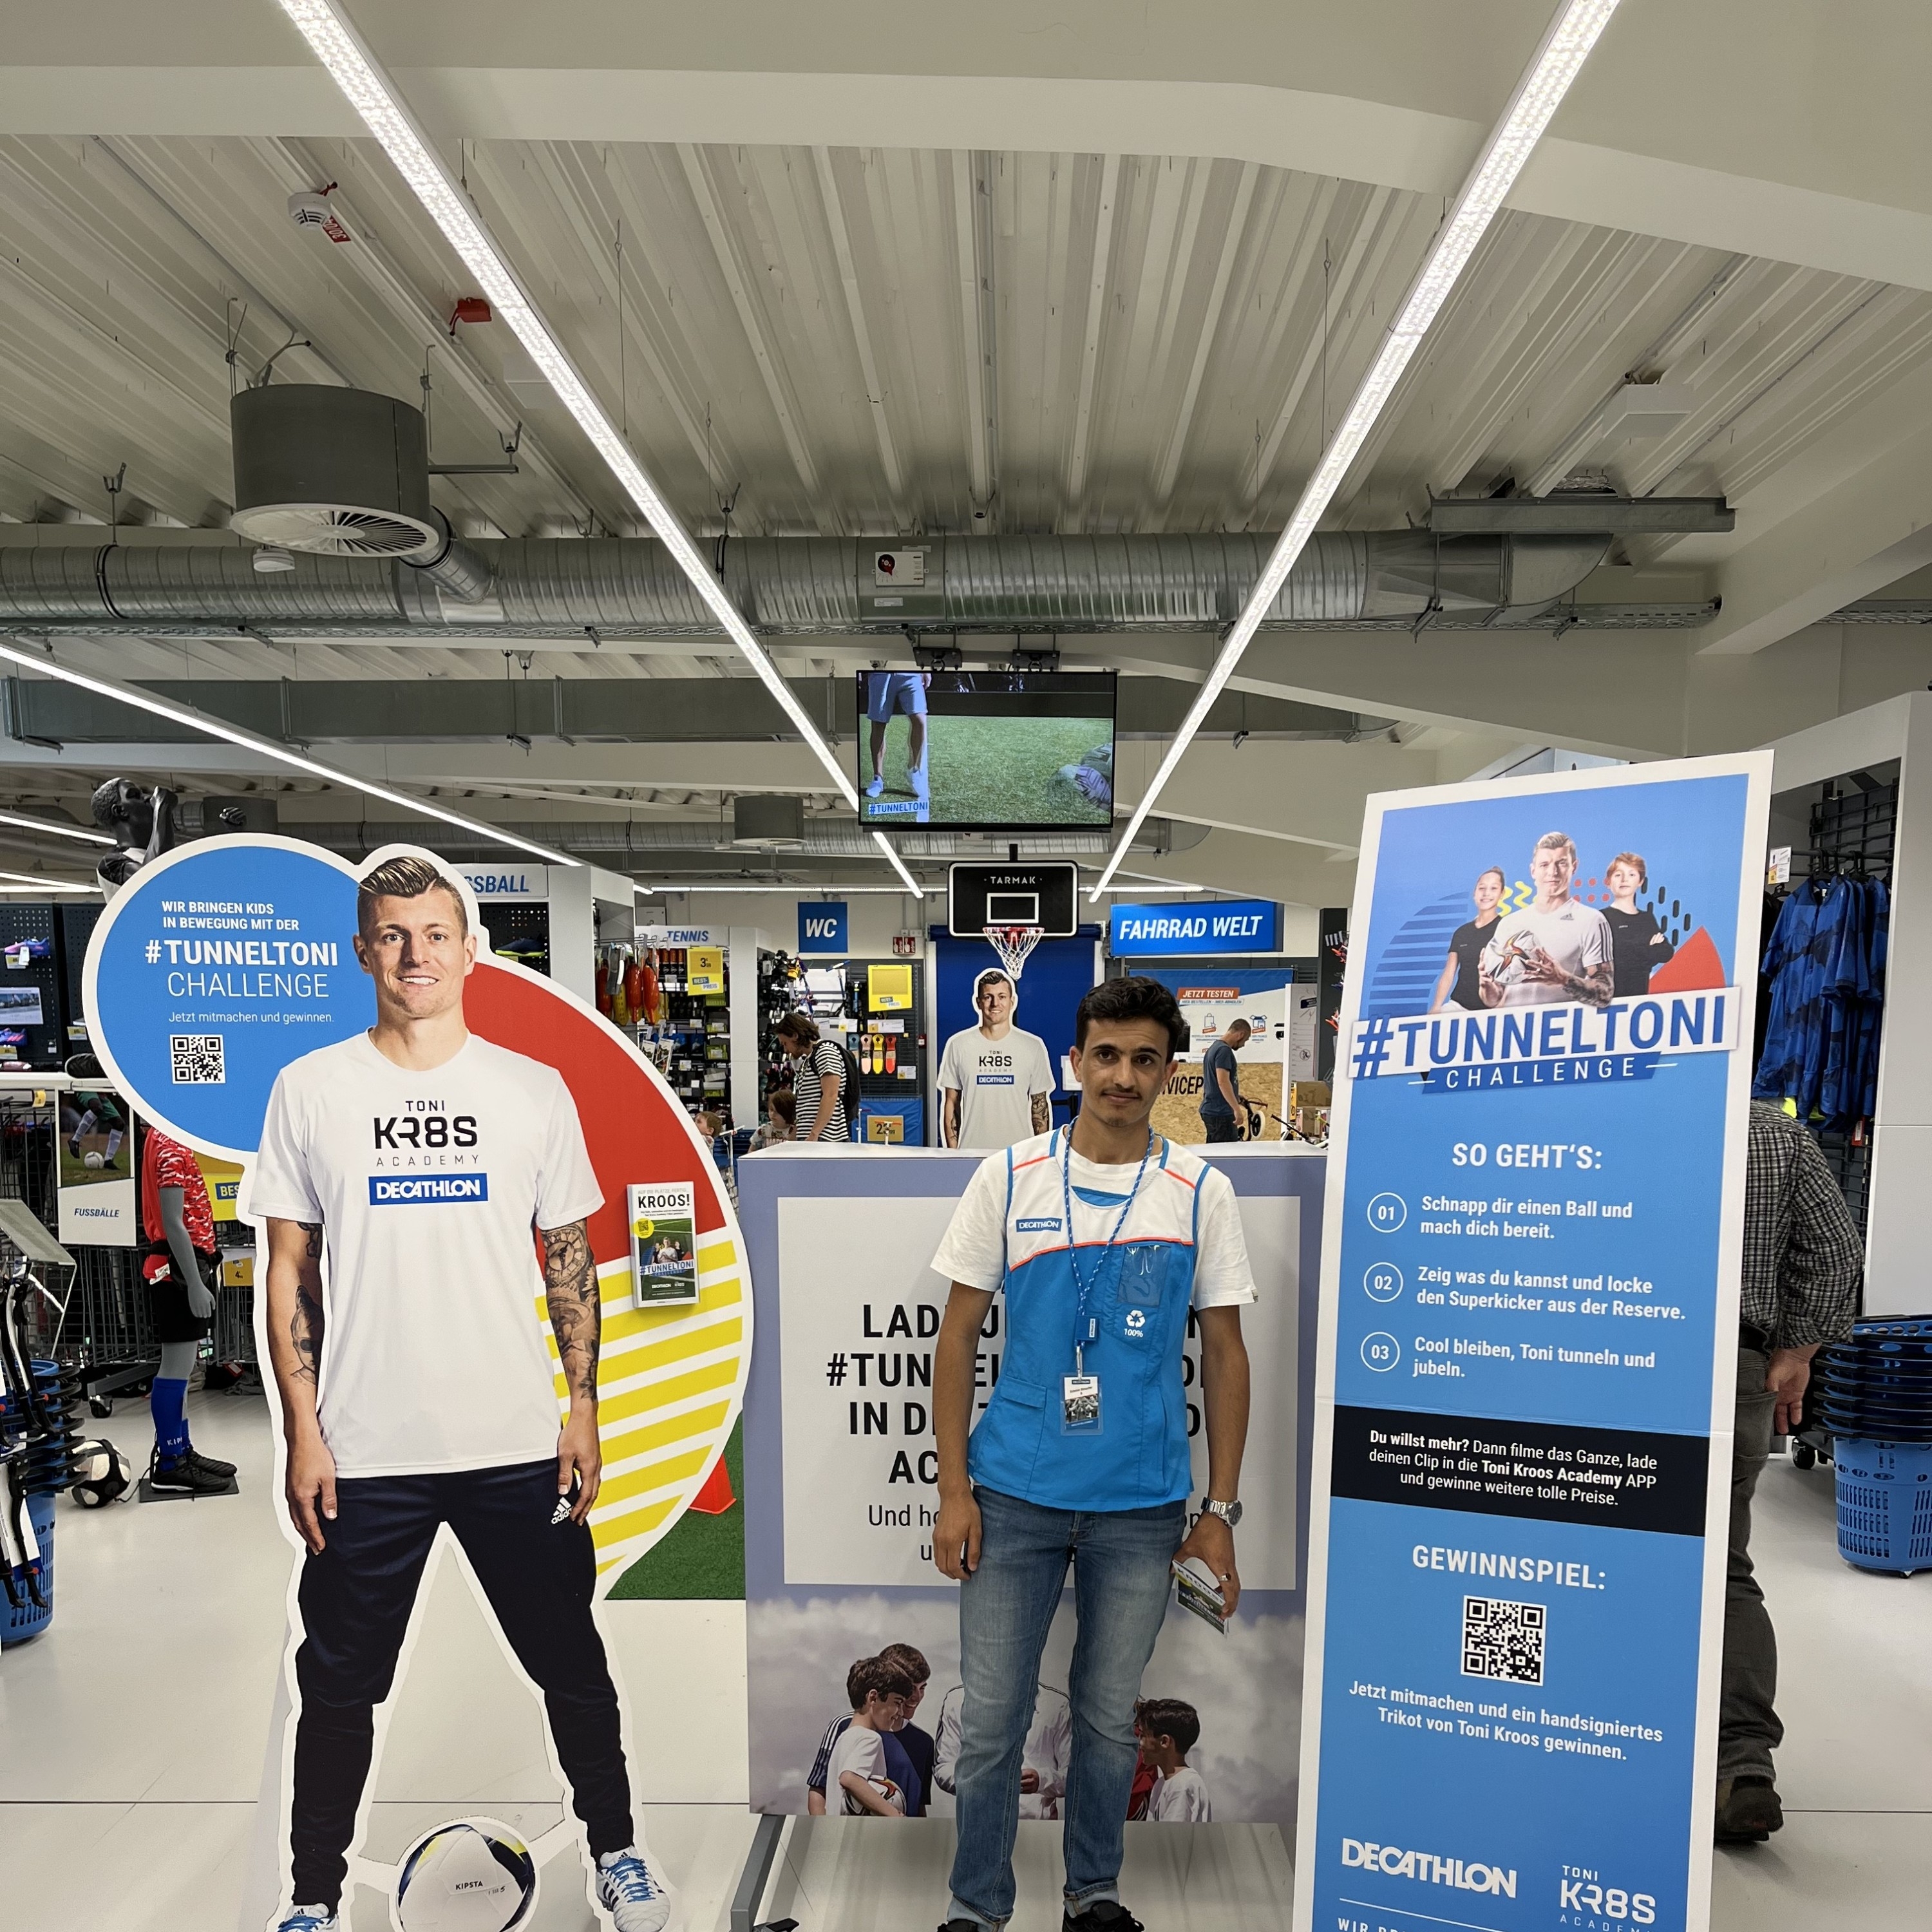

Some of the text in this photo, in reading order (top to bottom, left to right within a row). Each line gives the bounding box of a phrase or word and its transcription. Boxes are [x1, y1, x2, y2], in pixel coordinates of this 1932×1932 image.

[869, 801, 928, 815] #TUNNELTONI
[162, 901, 274, 914] WIR BRINGEN KIDS
[163, 917, 299, 931] IN BEWEGUNG MIT DER
[806, 918, 837, 938] WC
[1119, 916, 1263, 940] FAHRRAD WELT
[667, 931, 708, 942] TENNIS
[145, 940, 338, 966] #TUNNELTONI
[167, 972, 329, 998] CHALLENGE
[169, 1012, 334, 1024] Jetzt mitmachen und gewinnen.
[1353, 996, 1725, 1080] #TUNNELTONI
[1446, 1057, 1634, 1088] CHALLENGE
[406, 1100, 445, 1112] TONI
[374, 1116, 478, 1149] KR8S
[376, 1155, 478, 1167] ACADEMY
[1453, 1143, 1486, 1167] SO
[220, 1185, 239, 1197] BES
[376, 1179, 480, 1199] DECATHLON
[638, 1194, 690, 1208] KROOS!
[1422, 1196, 1632, 1218] Schnapp dir einen Ball und
[74, 1208, 120, 1218] FUSSBÄLLE
[1378, 1206, 1394, 1220] 01
[1019, 1220, 1059, 1229] DECATHLON
[1421, 1220, 1555, 1239] mach dich bereit.
[640, 1260, 694, 1275] #TUNNELTONI
[1374, 1275, 1392, 1290] 02
[1418, 1267, 1653, 1293] Zeig was du kannst und locke
[1417, 1289, 1685, 1320] den Superkicker aus der Reserve.
[864, 1304, 948, 1338] LAD
[1124, 1329, 1143, 1338] 100%
[1371, 1345, 1389, 1360] 03
[1415, 1337, 1654, 1367] Cool bleiben, Toni tunneln und
[1412, 1359, 1465, 1378] jubeln.
[850, 1402, 887, 1435] IN
[1370, 1430, 1657, 1469] Du willst mehr? Dann filme das Ganze, lade
[1369, 1450, 1656, 1488] deinen Clip in die Toni Kroos Academy APP
[1401, 1472, 1618, 1505] und gewinne weitere tolle Preise.
[869, 1504, 911, 1526] Und
[1413, 1545, 1605, 1589] GEWINNSPIEL:
[1349, 1681, 1663, 1741] Jetzt mitmachen und ein handsigniertes
[1378, 1707, 1627, 1760] Trikot von Toni Kroos gewinnen.
[1341, 1838, 1517, 1898] DECATHLON
[1562, 1865, 1598, 1881] TONI
[455, 1880, 483, 1890] KIPSTA
[1560, 1879, 1656, 1924] KR8S
[1338, 1918, 1368, 1932] WIR
